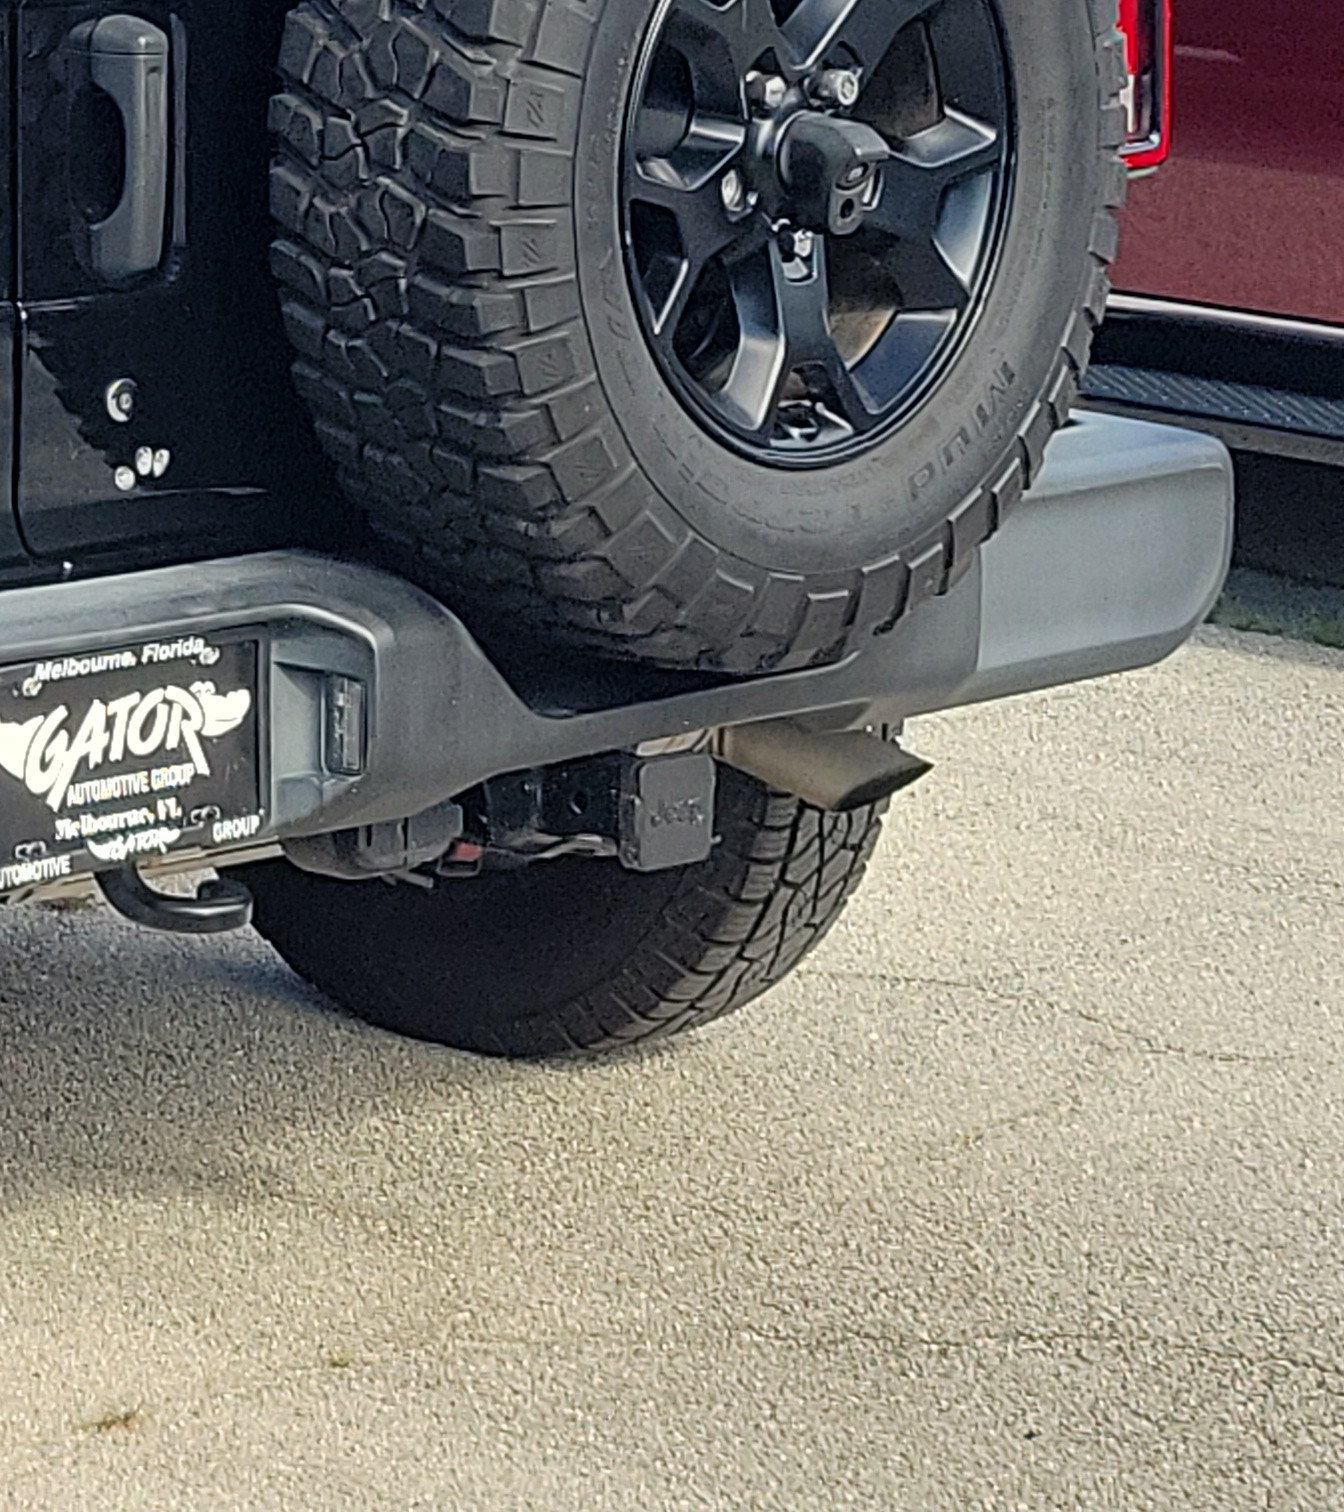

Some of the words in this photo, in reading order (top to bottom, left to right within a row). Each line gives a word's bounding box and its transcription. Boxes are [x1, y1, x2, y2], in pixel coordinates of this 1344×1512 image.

[141, 636, 206, 666] Florida
[24, 685, 210, 813] GATOR
[67, 772, 149, 805] AUTOMOTIVE
[150, 763, 195, 790] GROUP
[212, 814, 261, 843] GROUP
